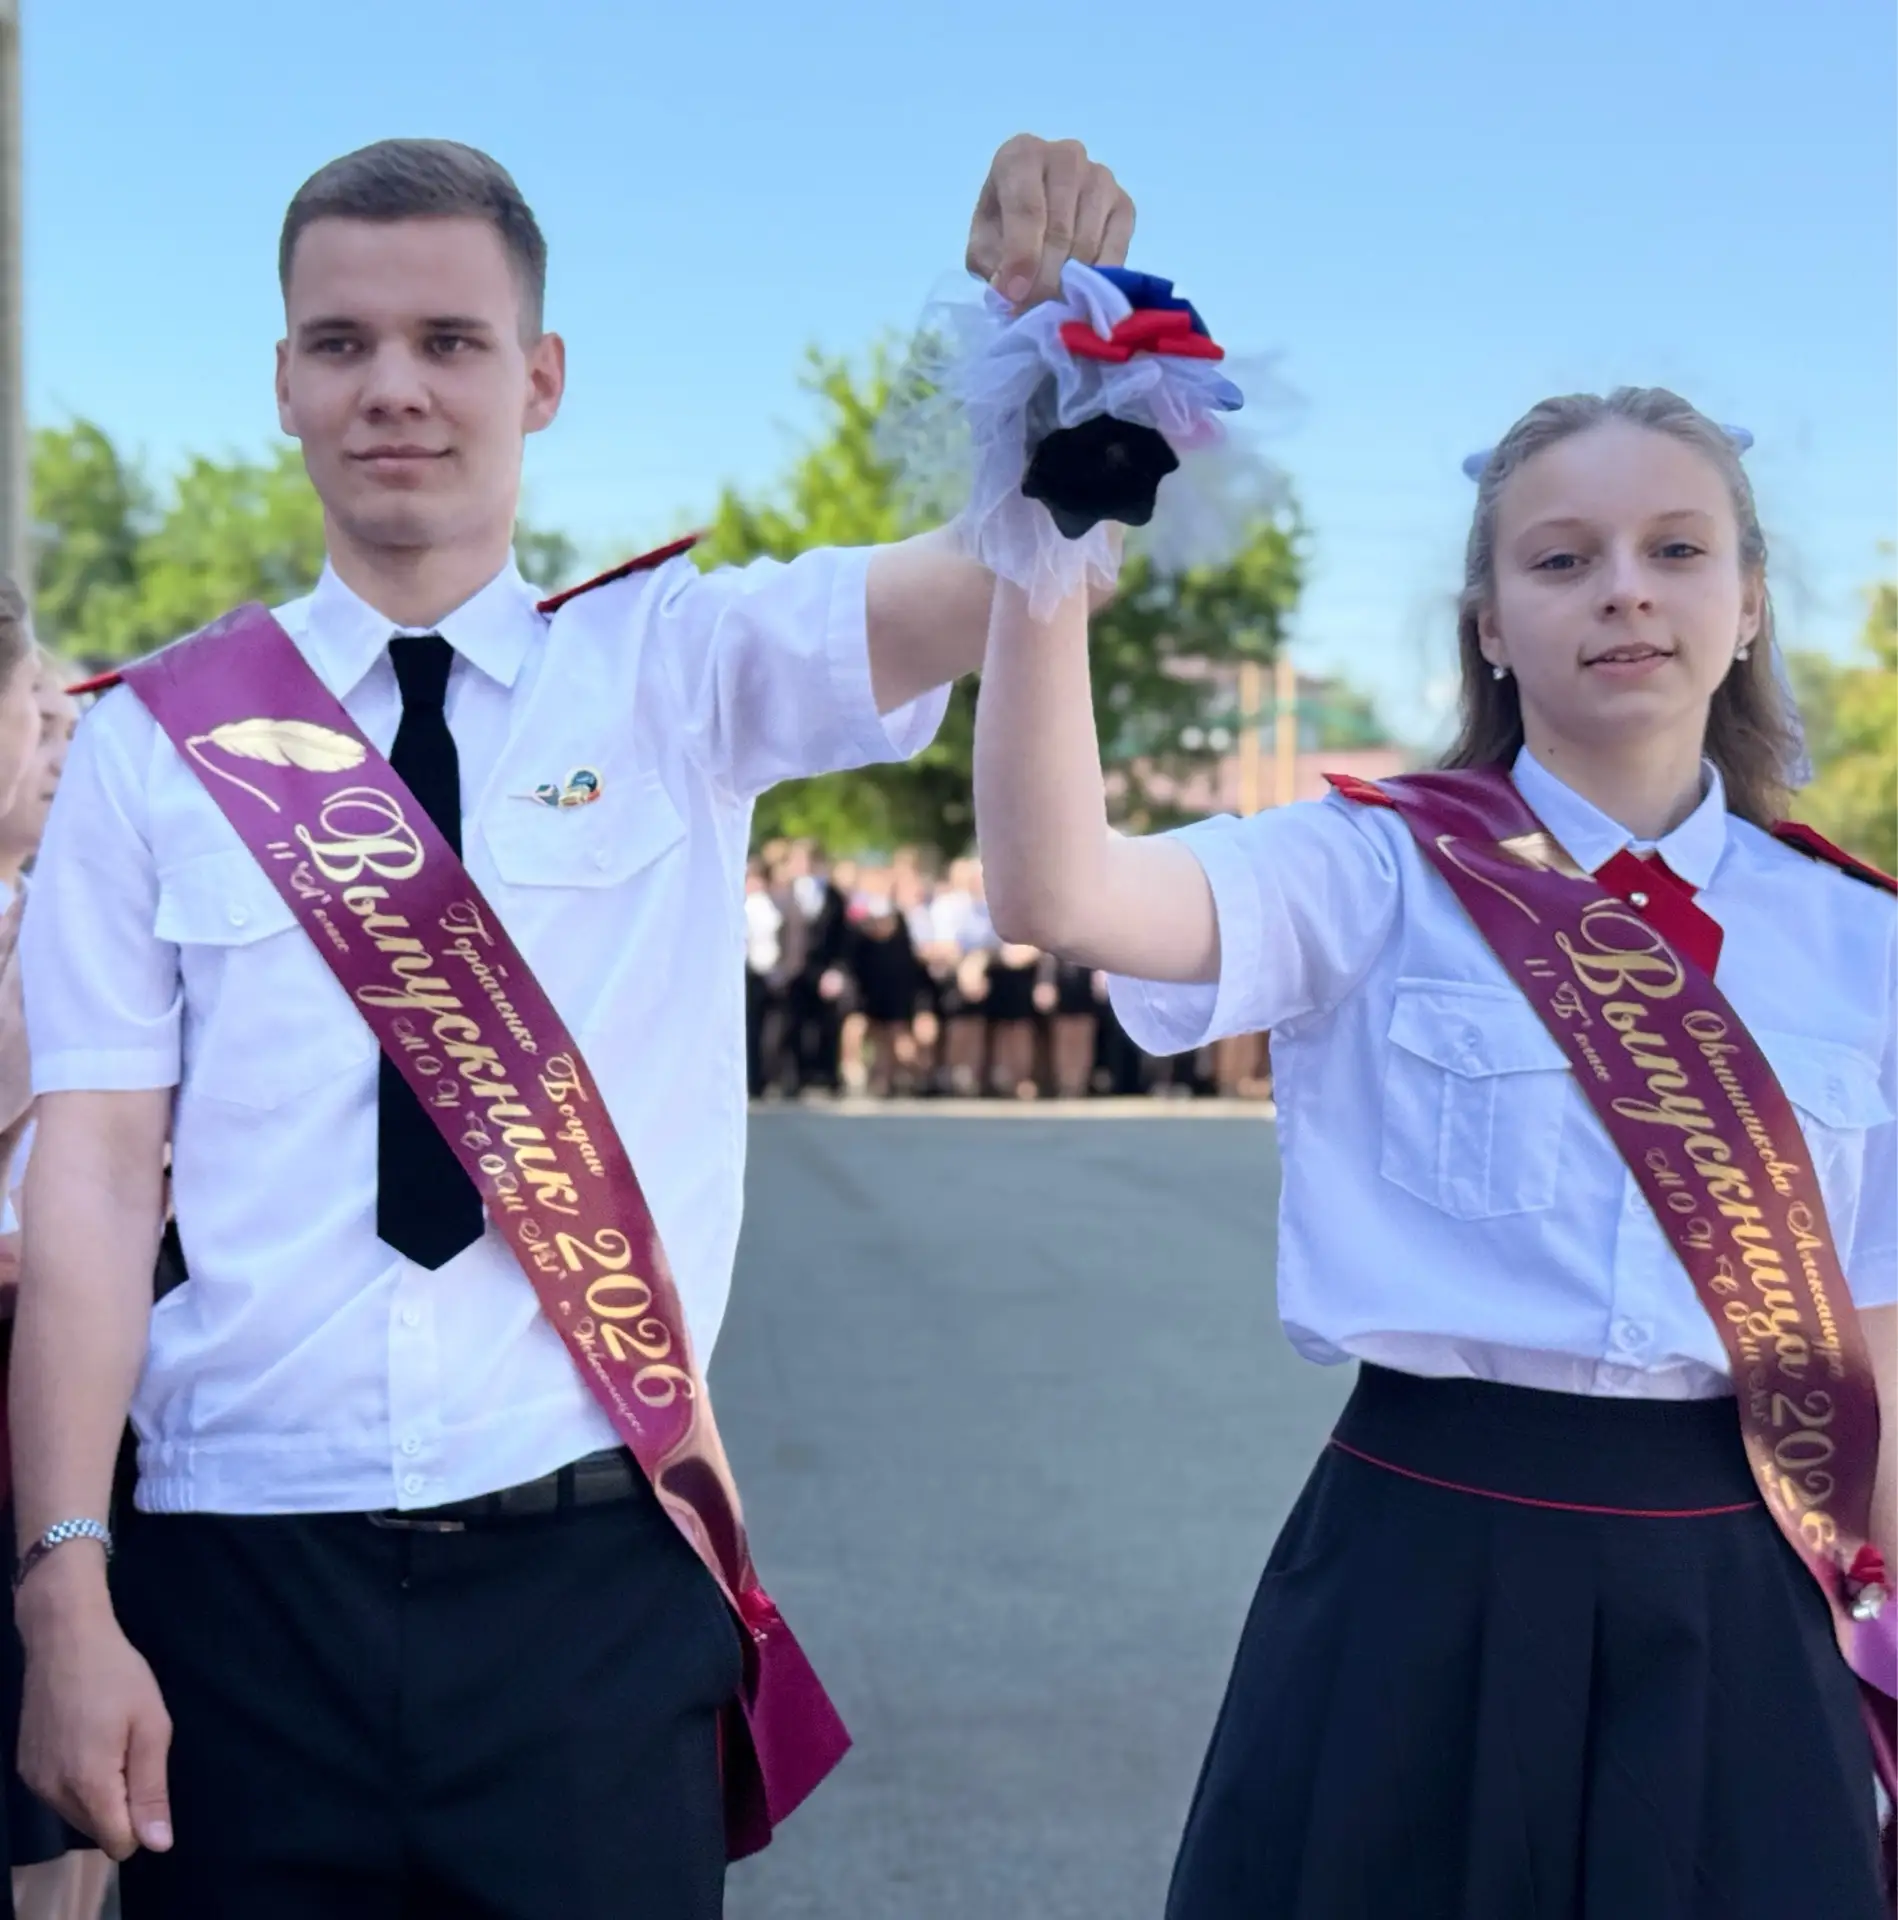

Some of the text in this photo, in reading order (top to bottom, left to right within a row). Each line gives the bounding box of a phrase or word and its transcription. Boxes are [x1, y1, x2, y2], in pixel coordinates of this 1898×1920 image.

[265, 841, 297, 860] 11
[294, 786, 696, 1409] Выпускник 2026
[538, 1052, 605, 1178] Богдан
[1523, 958, 1557, 977] 11
[1572, 1032, 1613, 1082] класс
[1555, 897, 1837, 1553] Выпускница 2026
[1681, 1010, 1846, 1379] Овчинникова Александра
